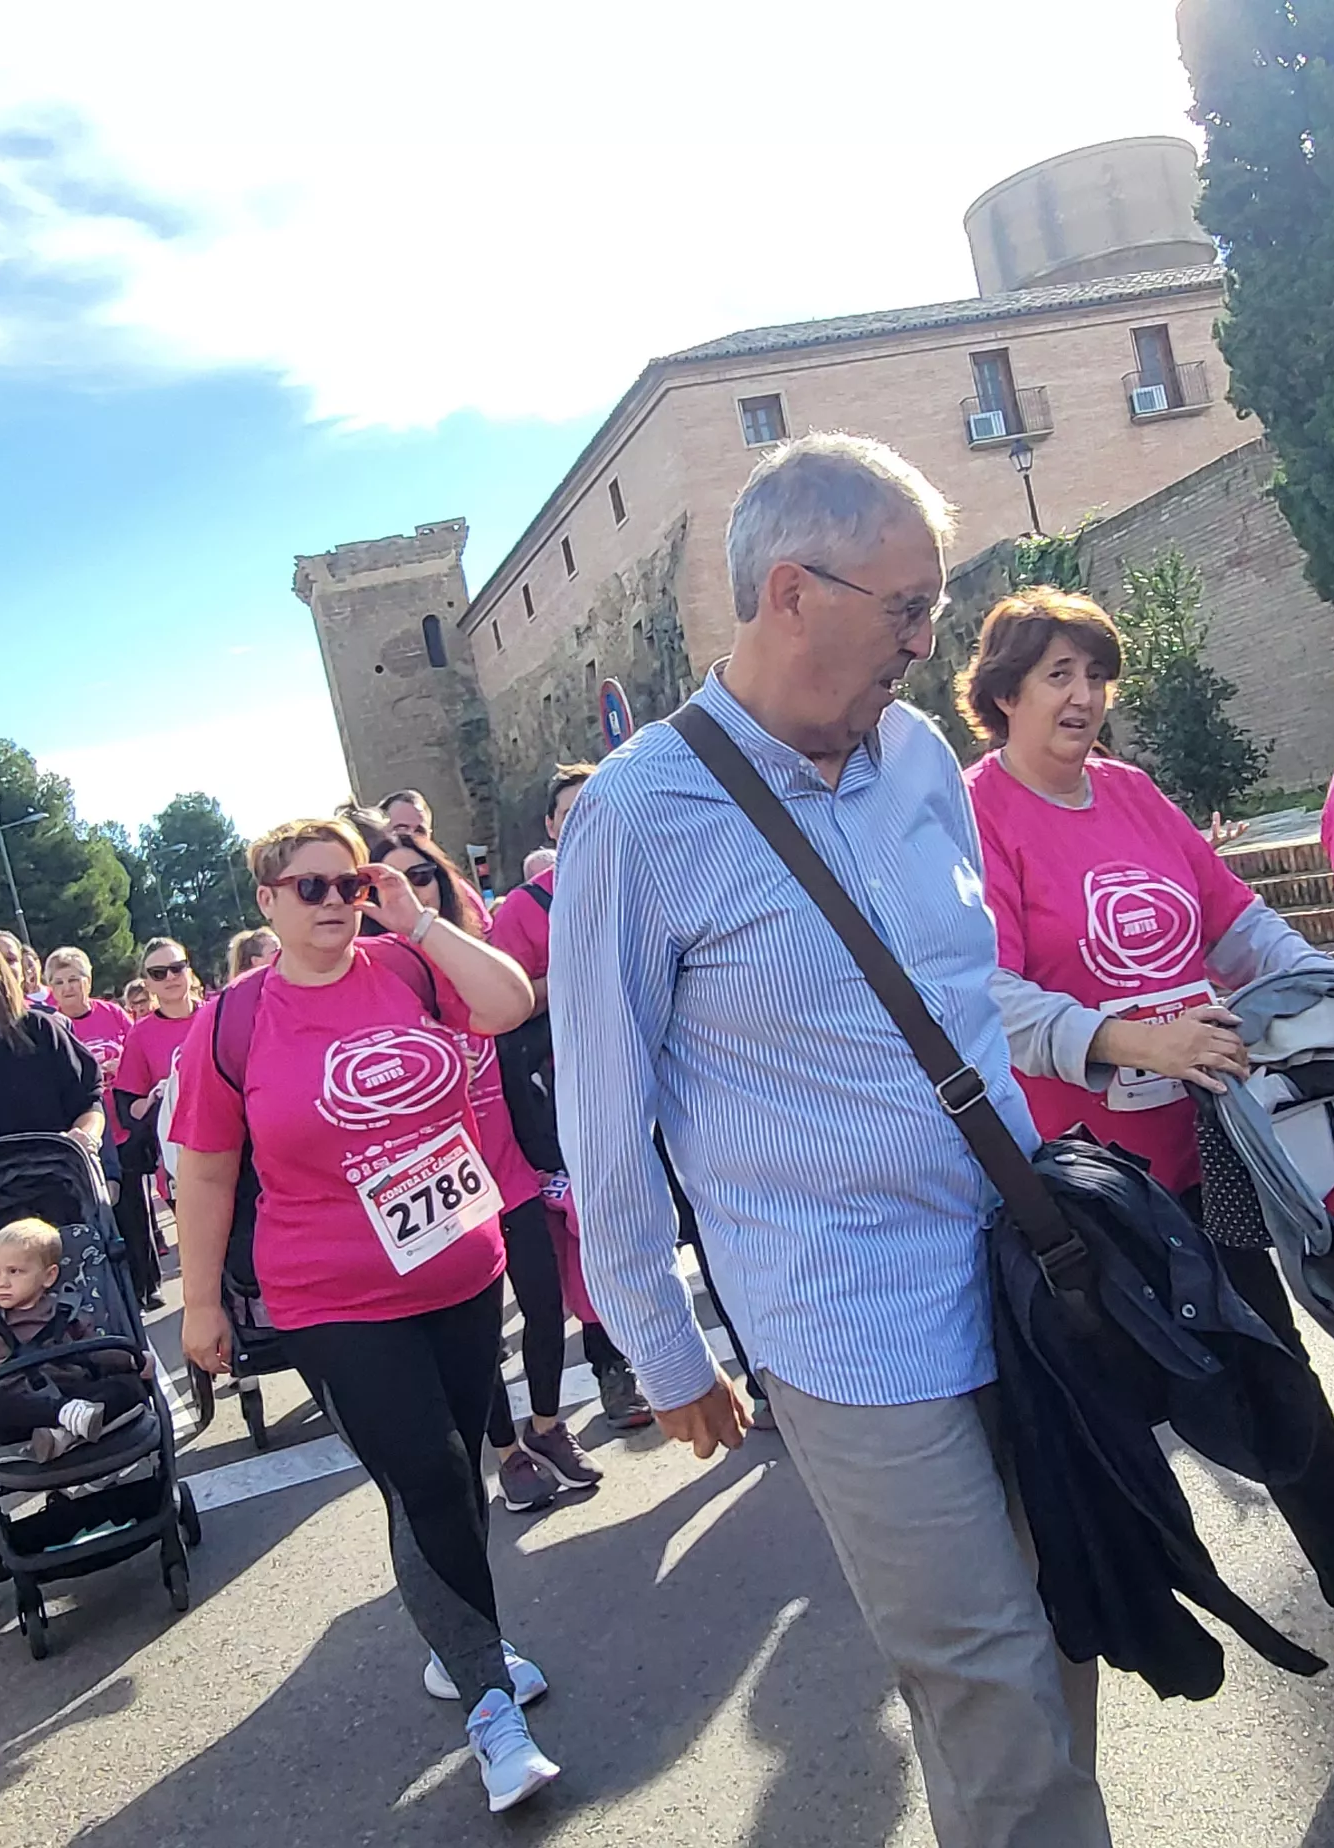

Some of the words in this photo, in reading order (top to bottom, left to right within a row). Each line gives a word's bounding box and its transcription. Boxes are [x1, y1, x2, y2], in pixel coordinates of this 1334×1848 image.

[379, 1174, 421, 1203] CONTRA
[420, 1168, 433, 1180] EL
[386, 1158, 482, 1242] 2786
